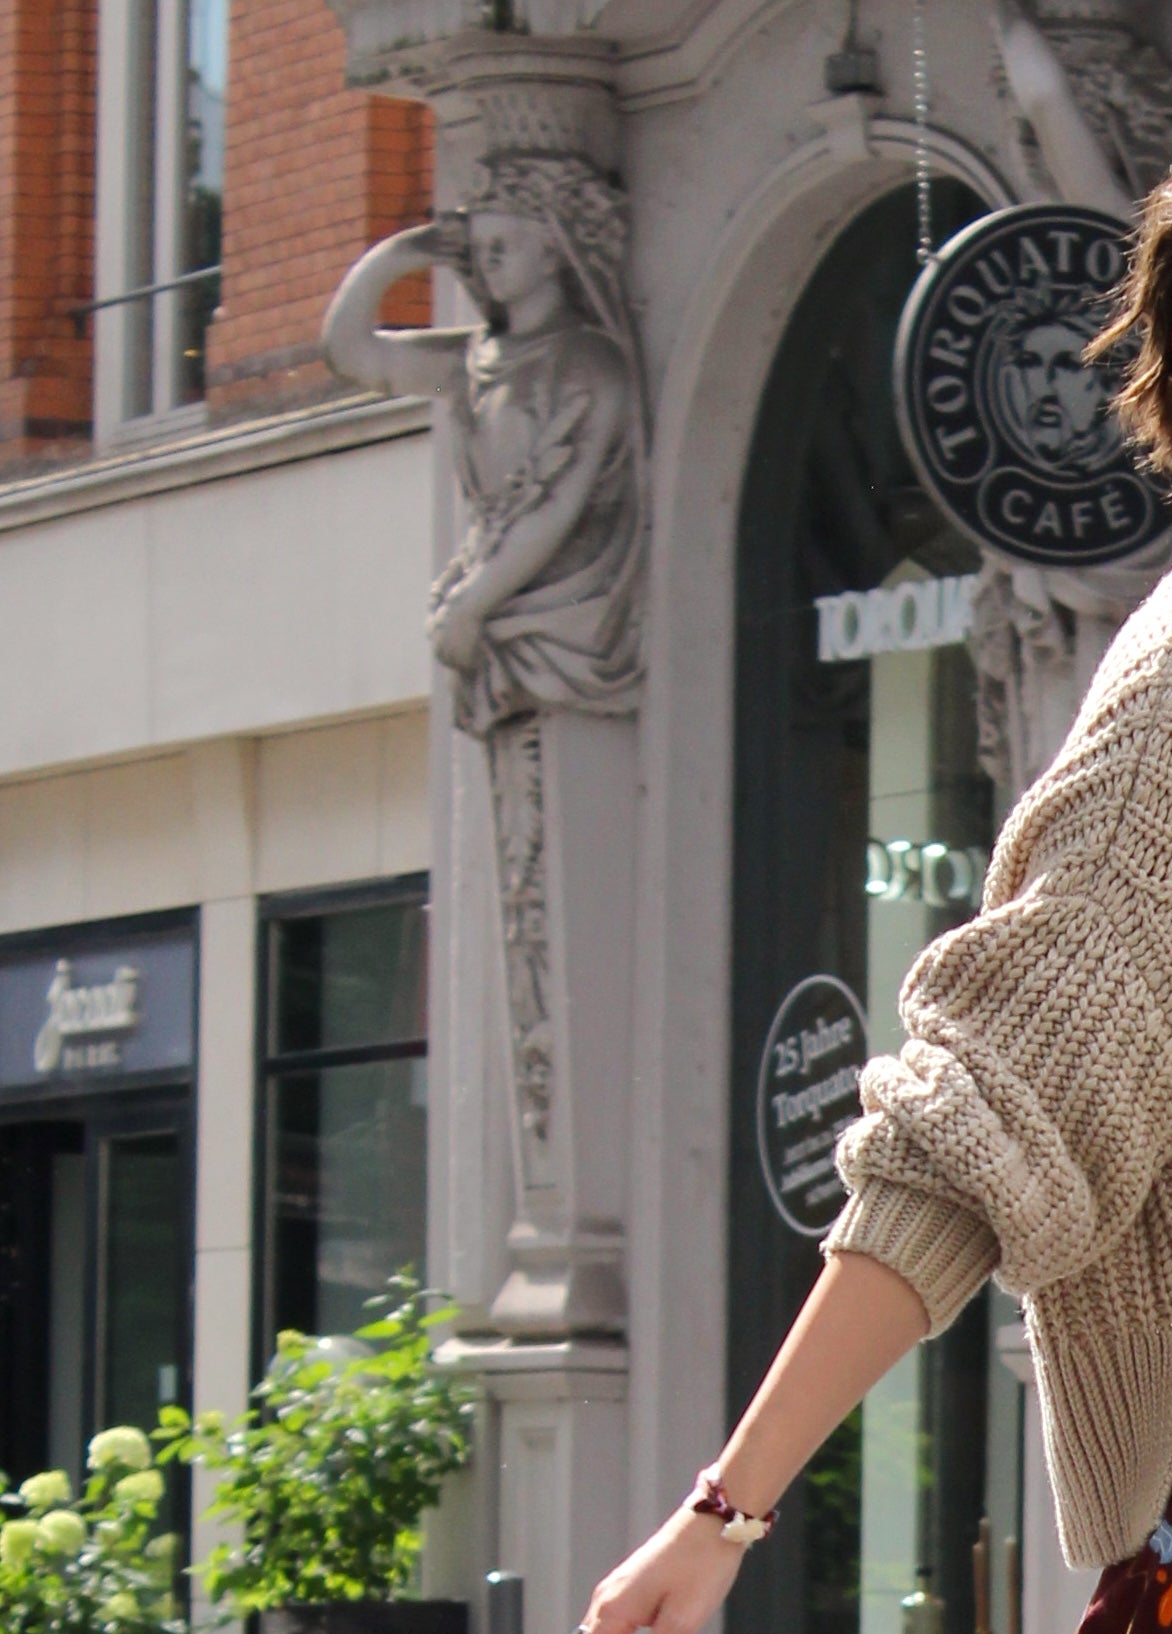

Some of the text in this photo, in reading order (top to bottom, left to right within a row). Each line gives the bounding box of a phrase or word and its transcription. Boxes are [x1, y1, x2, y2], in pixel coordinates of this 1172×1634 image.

[926, 229, 1122, 461] TORQUATO
[775, 1016, 852, 1078] 25 Jahre
